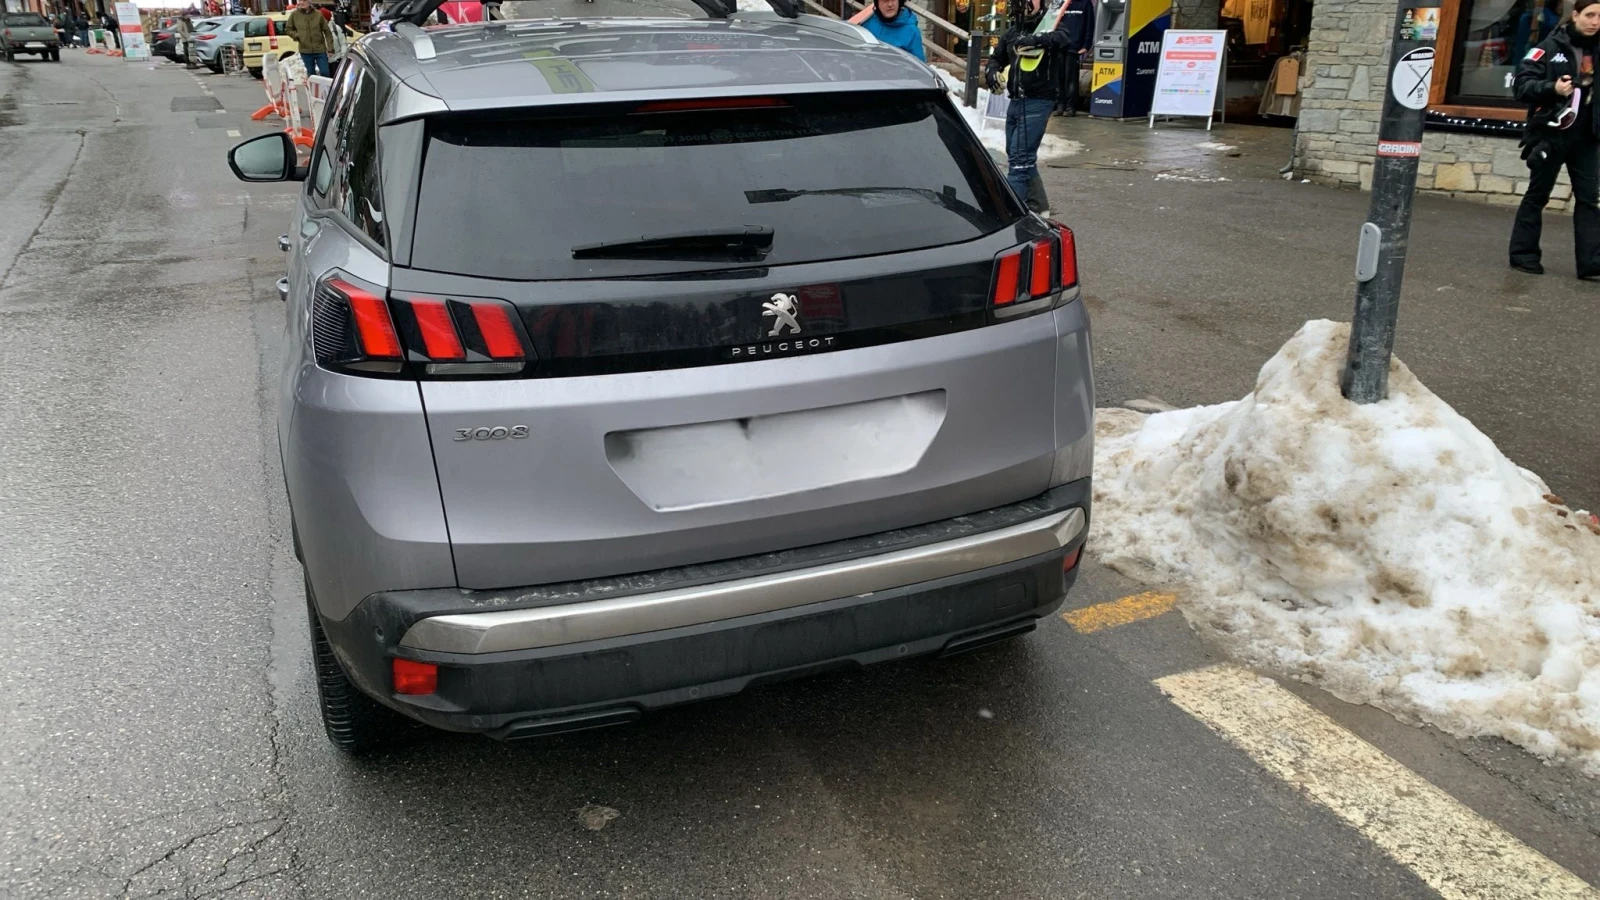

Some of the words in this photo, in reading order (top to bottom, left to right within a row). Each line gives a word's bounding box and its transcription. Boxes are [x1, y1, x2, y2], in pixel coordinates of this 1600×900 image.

[1137, 41, 1160, 54] ATM
[1099, 67, 1115, 75] ATM
[1095, 97, 1113, 105] Euronet
[731, 336, 834, 356] PEUGEOT
[453, 424, 530, 441] 3008
